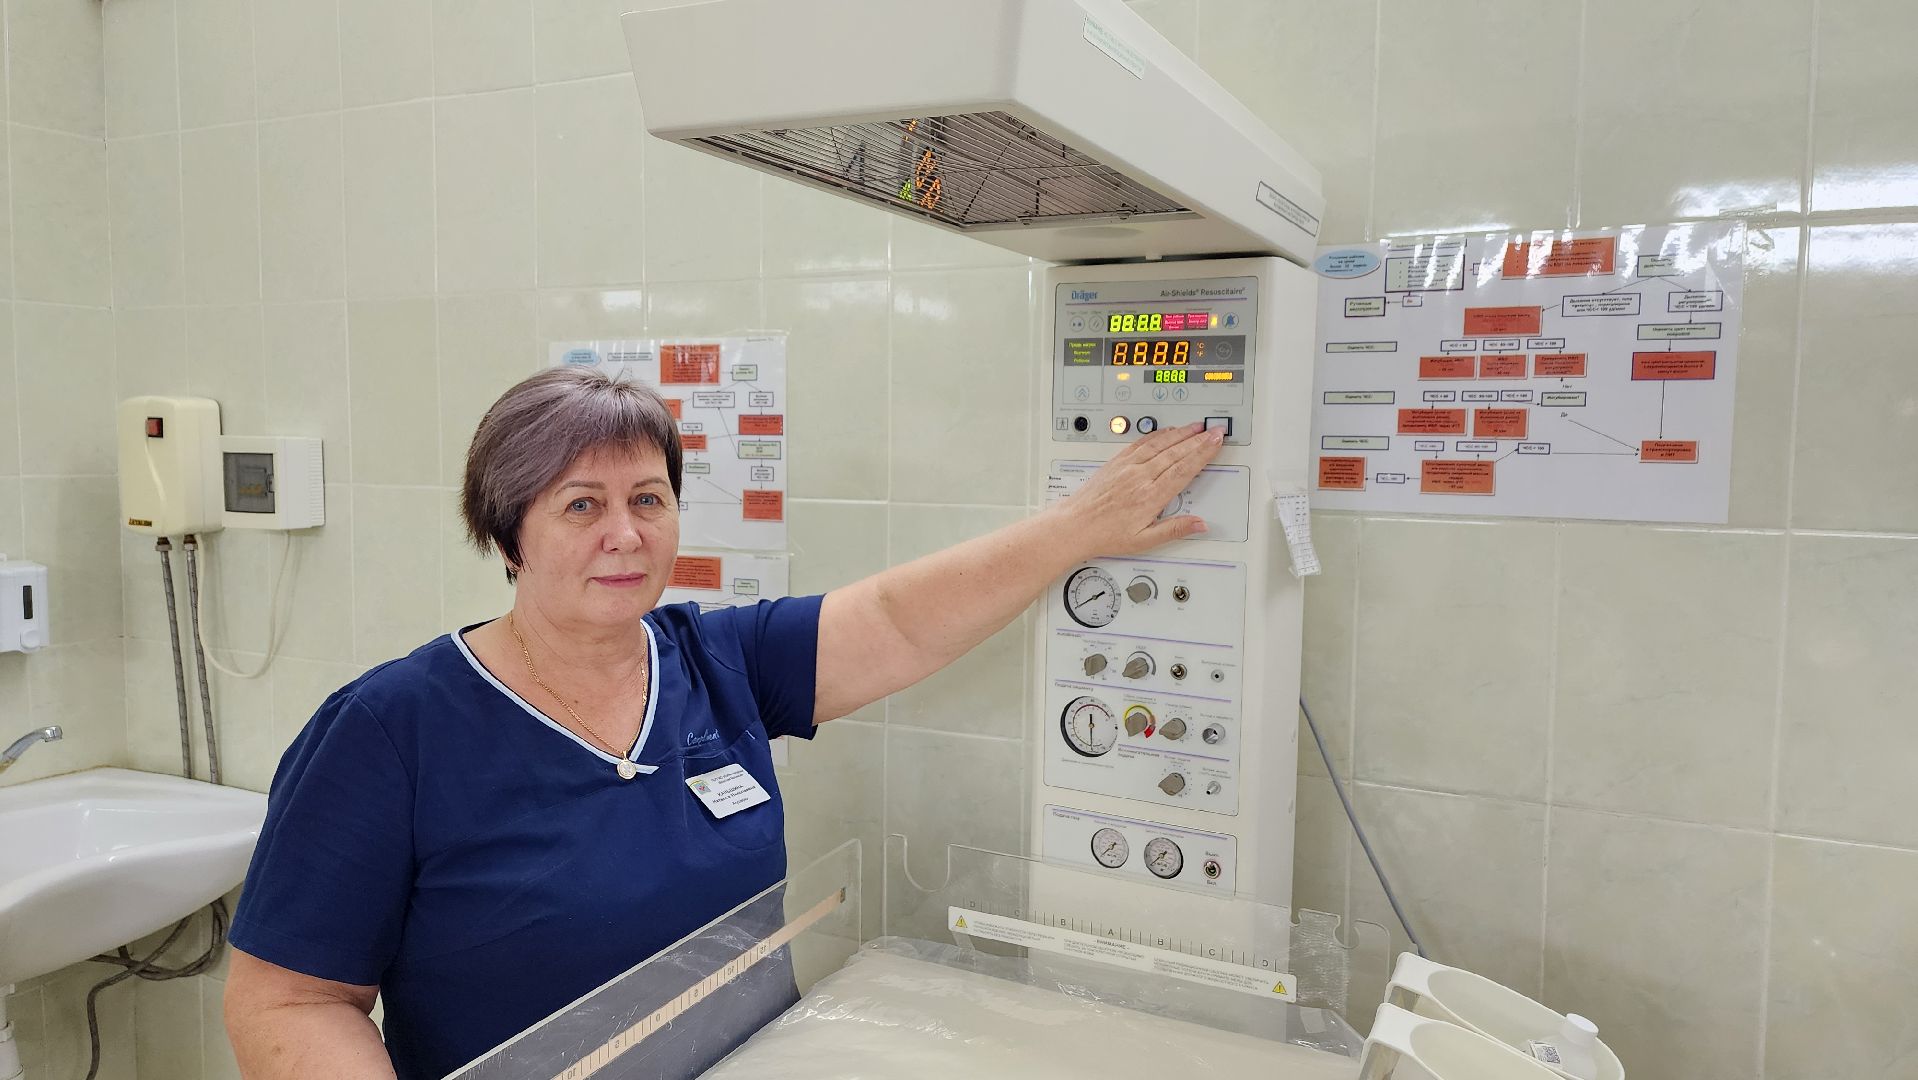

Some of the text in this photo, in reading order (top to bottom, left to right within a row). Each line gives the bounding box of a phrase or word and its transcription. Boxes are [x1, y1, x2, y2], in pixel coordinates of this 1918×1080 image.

[1071, 290, 1097, 301] Dräger
[1060, 918, 1066, 926] B
[1107, 928, 1114, 936] A
[1157, 938, 1164, 946] B
[1208, 948, 1216, 957] C
